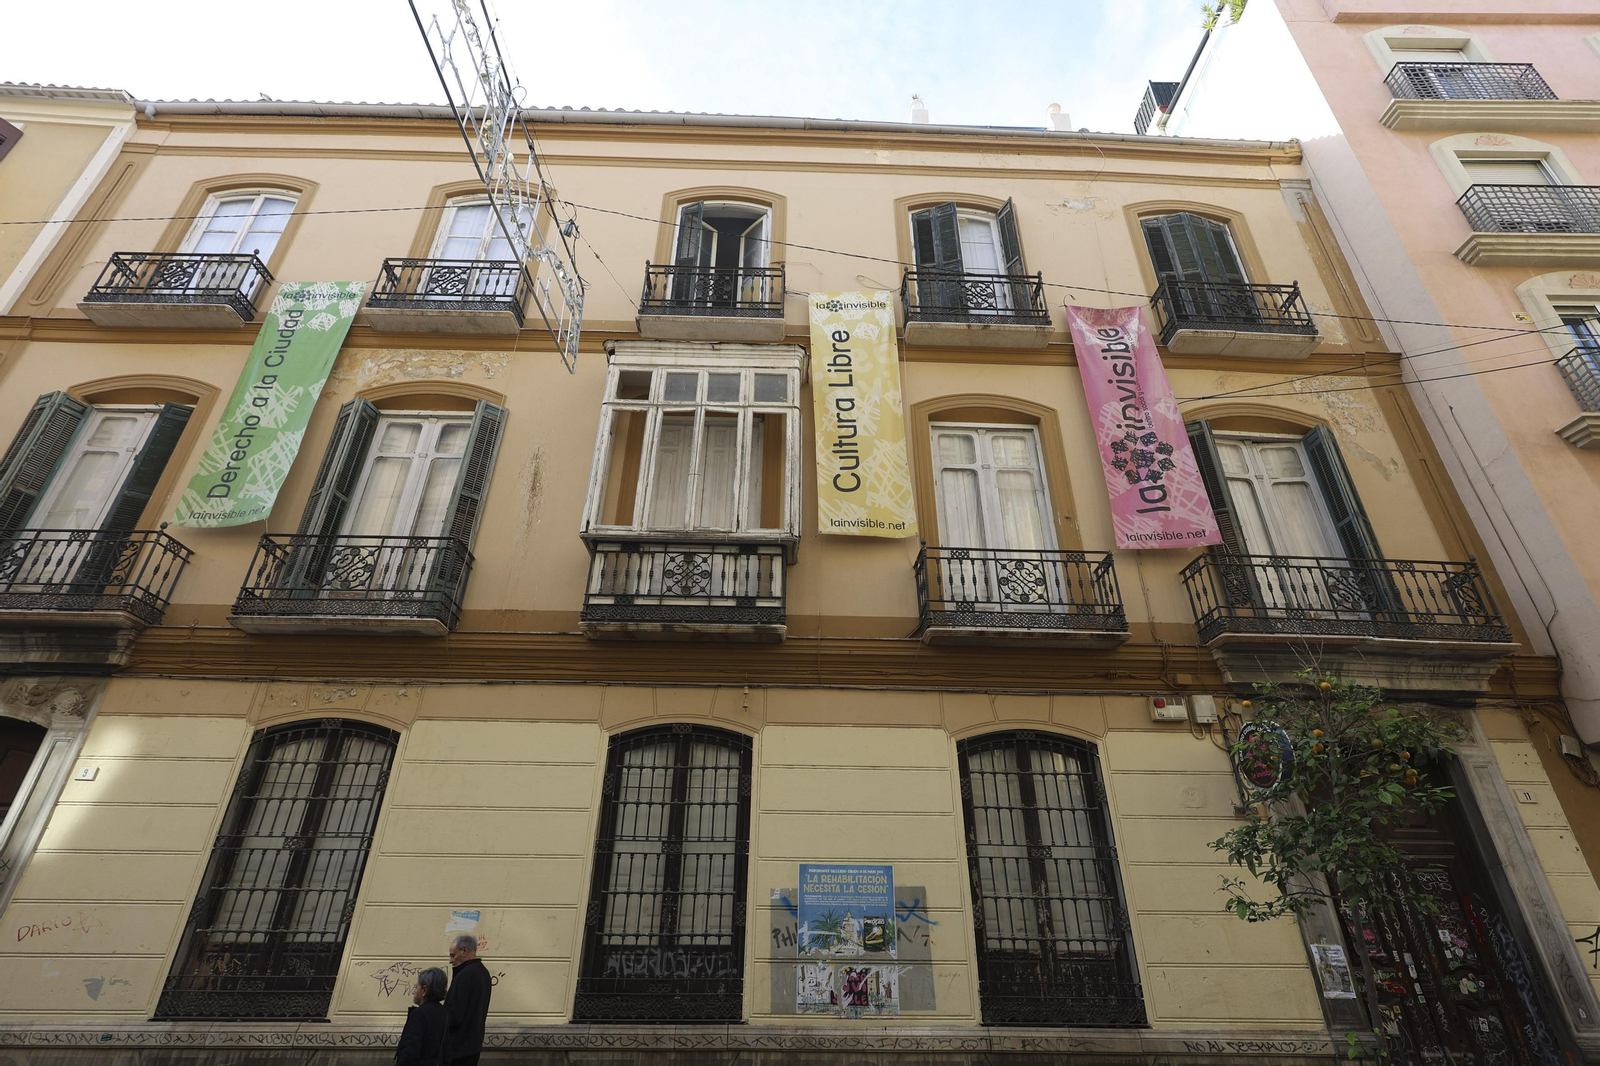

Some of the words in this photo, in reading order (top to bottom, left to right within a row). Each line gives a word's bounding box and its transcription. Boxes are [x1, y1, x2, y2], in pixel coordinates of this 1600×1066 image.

[310, 290, 356, 299] invisible
[816, 301, 826, 309] la
[842, 300, 887, 309] invisible
[264, 309, 304, 368] Ciudad
[827, 330, 854, 387] Libre
[254, 374, 279, 390] la
[1096, 327, 1146, 431] invisible
[251, 397, 269, 408] a
[832, 397, 861, 493] Cultura
[206, 415, 261, 499] Derecho
[1136, 484, 1171, 514] la
[188, 505, 267, 520] lainvisible.net
[830, 518, 906, 532] lainvisible.net
[1125, 528, 1208, 542] lainvisible.net
[82, 768, 90, 778] 9
[1523, 792, 1532, 800] 11
[821, 873, 888, 884] REHABILITACIÓN
[803, 884, 840, 893] NECESITA
[844, 884, 854, 893] LA
[1182, 1040, 1206, 1052] NO
